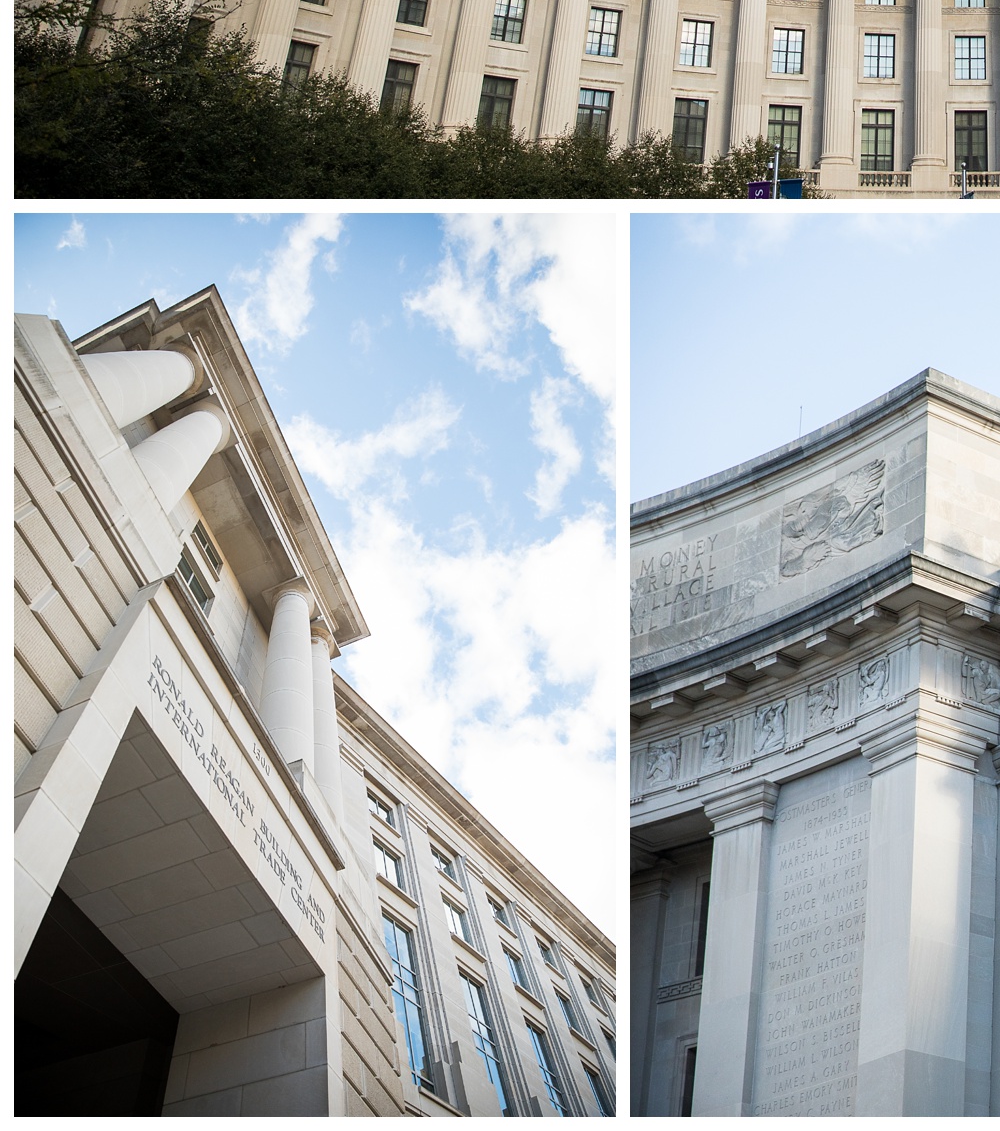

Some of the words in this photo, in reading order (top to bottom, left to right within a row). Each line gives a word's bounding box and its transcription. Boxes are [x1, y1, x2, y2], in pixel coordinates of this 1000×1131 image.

[640, 534, 718, 576] MONEY
[646, 556, 716, 594] RURAL
[630, 574, 714, 617] VILLAGE
[152, 654, 204, 738] RONALD
[210, 743, 254, 817] REAGAN
[260, 818, 302, 890] BUILDING
[307, 894, 326, 924] AND
[147, 672, 246, 828] INTERNATIONAL
[252, 828, 286, 886] TRADE
[290, 887, 326, 944] CENTER
[804, 806, 848, 830] 1874-1933
[777, 837, 807, 855] JAMES
[780, 845, 829, 871] MARSHALL
[835, 830, 869, 851] JEWELL
[784, 867, 814, 885] JAMES
[833, 849, 862, 867] TYNER
[784, 883, 813, 901] DAVID
[845, 864, 862, 879] KEY
[776, 898, 816, 920] HORACE
[823, 879, 867, 904] MAYNARD
[777, 914, 818, 936] THOMAS
[835, 897, 864, 916] JAMES
[774, 930, 819, 953] TIMOTHY
[838, 913, 866, 932] HOWE
[769, 953, 804, 971] WALTER
[780, 967, 810, 985] FRANK
[817, 951, 856, 973] HATTON
[775, 982, 816, 1002] WILLIAM
[833, 968, 858, 984] VILAS
[767, 1024, 795, 1042] JOHN
[802, 1003, 861, 1030] WANAMAKER
[768, 1008, 789, 1024] DON
[766, 1039, 805, 1059] WILSON
[824, 1020, 860, 1042] BISSELL
[766, 1056, 806, 1076] WILLIAM
[821, 1039, 859, 1059] WILSON
[772, 1075, 805, 1093] JAMES
[811, 1072, 818, 1082] A.
[823, 1060, 849, 1077] GARY
[754, 1095, 794, 1116] CHARLES
[800, 1083, 833, 1103] EMORY
[821, 1097, 851, 1115] PAYNE
